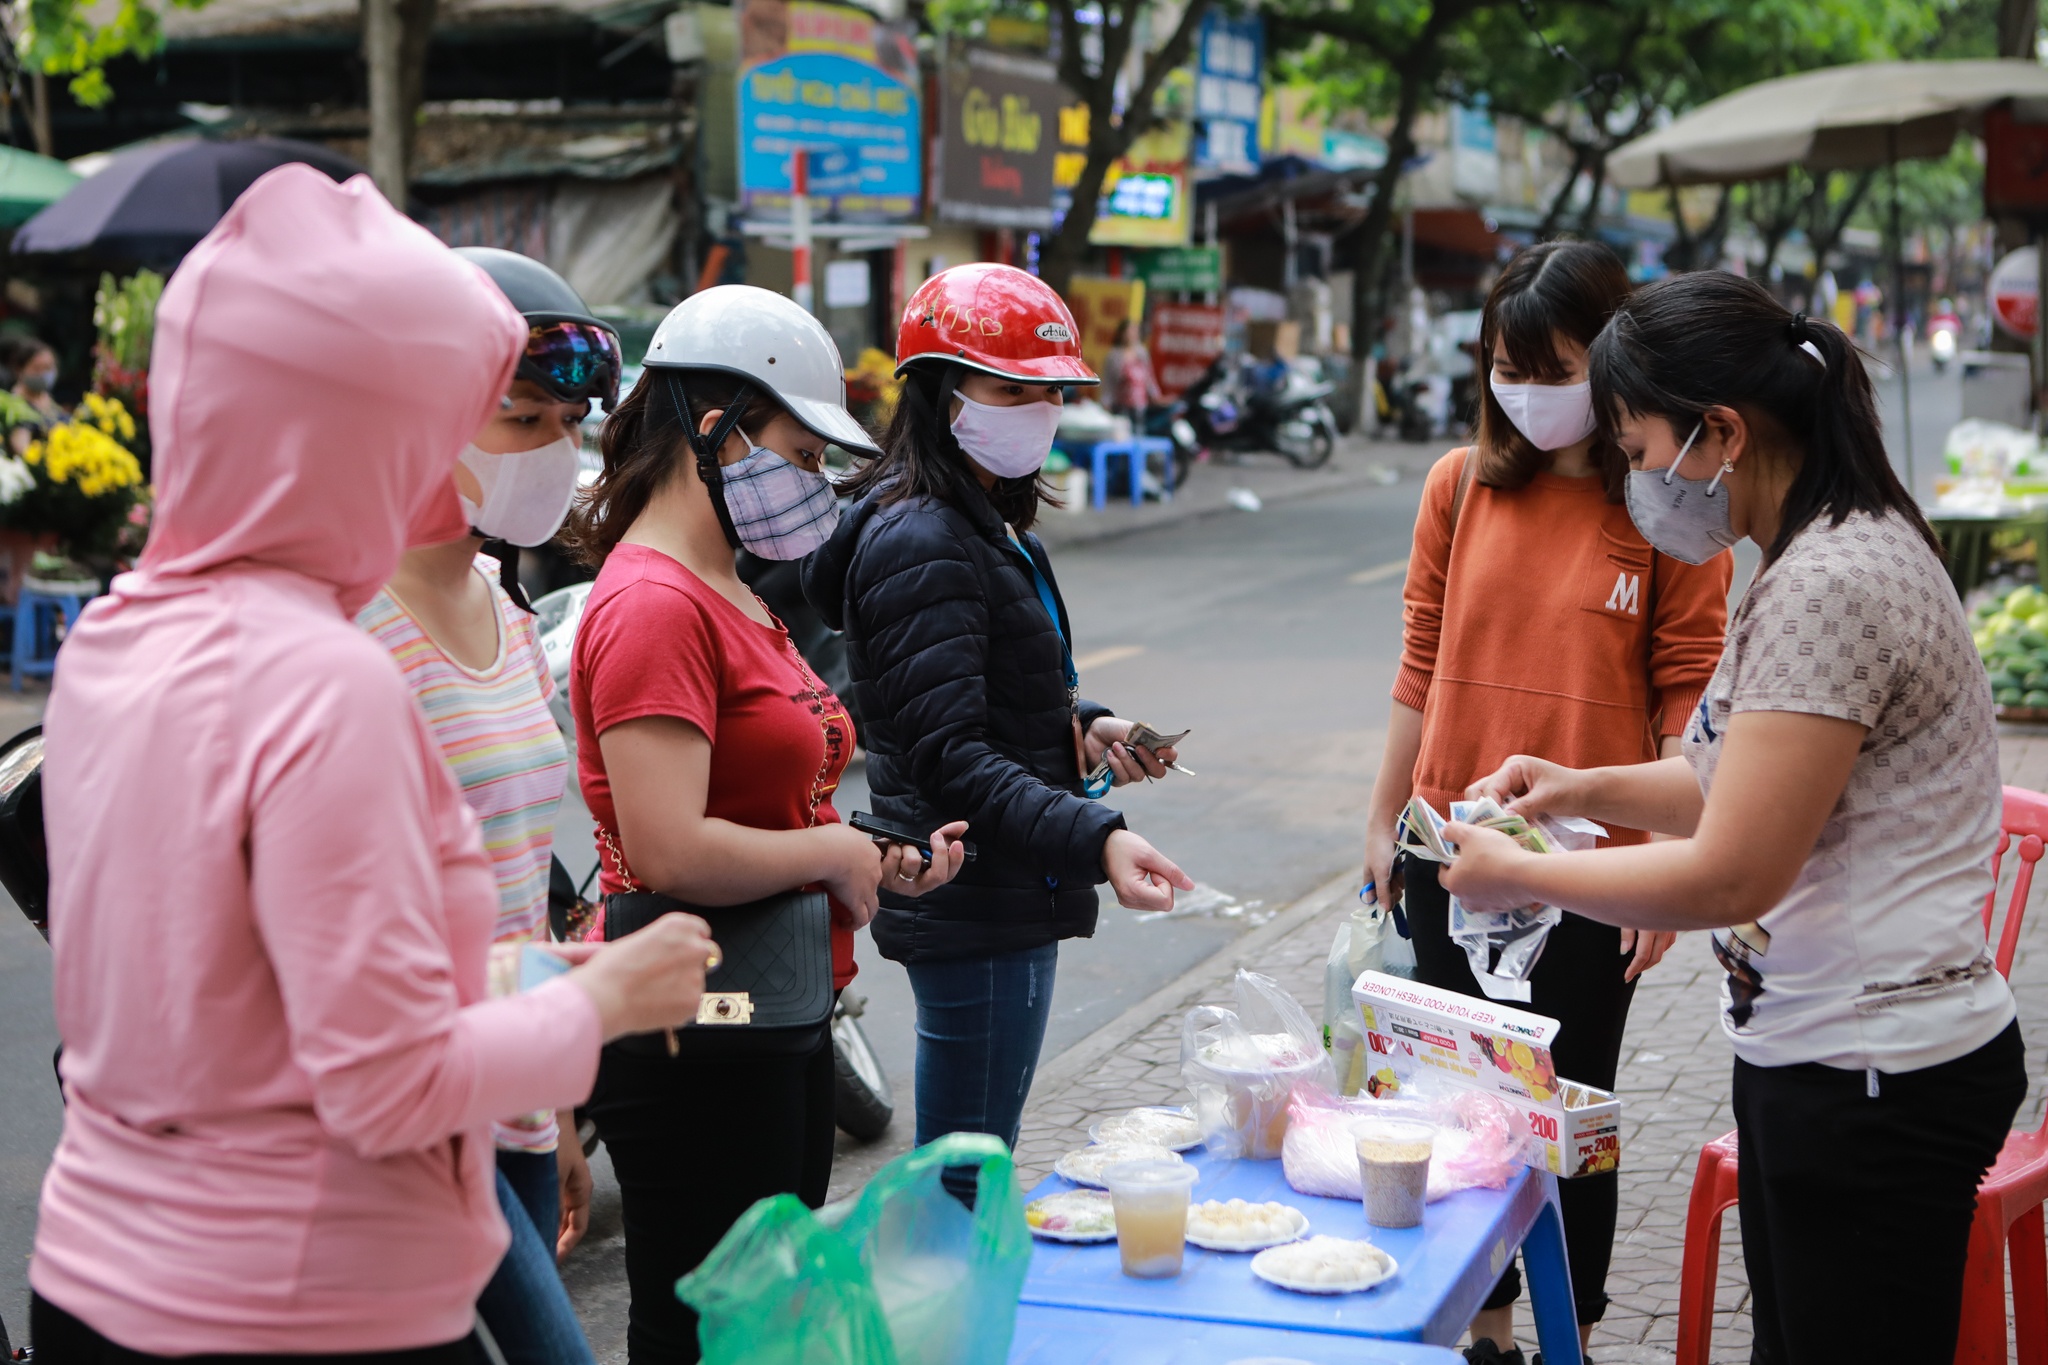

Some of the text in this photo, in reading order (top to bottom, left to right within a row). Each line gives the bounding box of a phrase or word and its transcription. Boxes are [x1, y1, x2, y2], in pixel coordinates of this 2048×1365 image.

[1042, 325, 1068, 338] Asia
[1605, 572, 1639, 616] M
[1362, 981, 1497, 1025] KEEP YOUR FOOD FRESH LONGER
[1528, 1111, 1558, 1142] 200
[1594, 1134, 1617, 1153] 200
